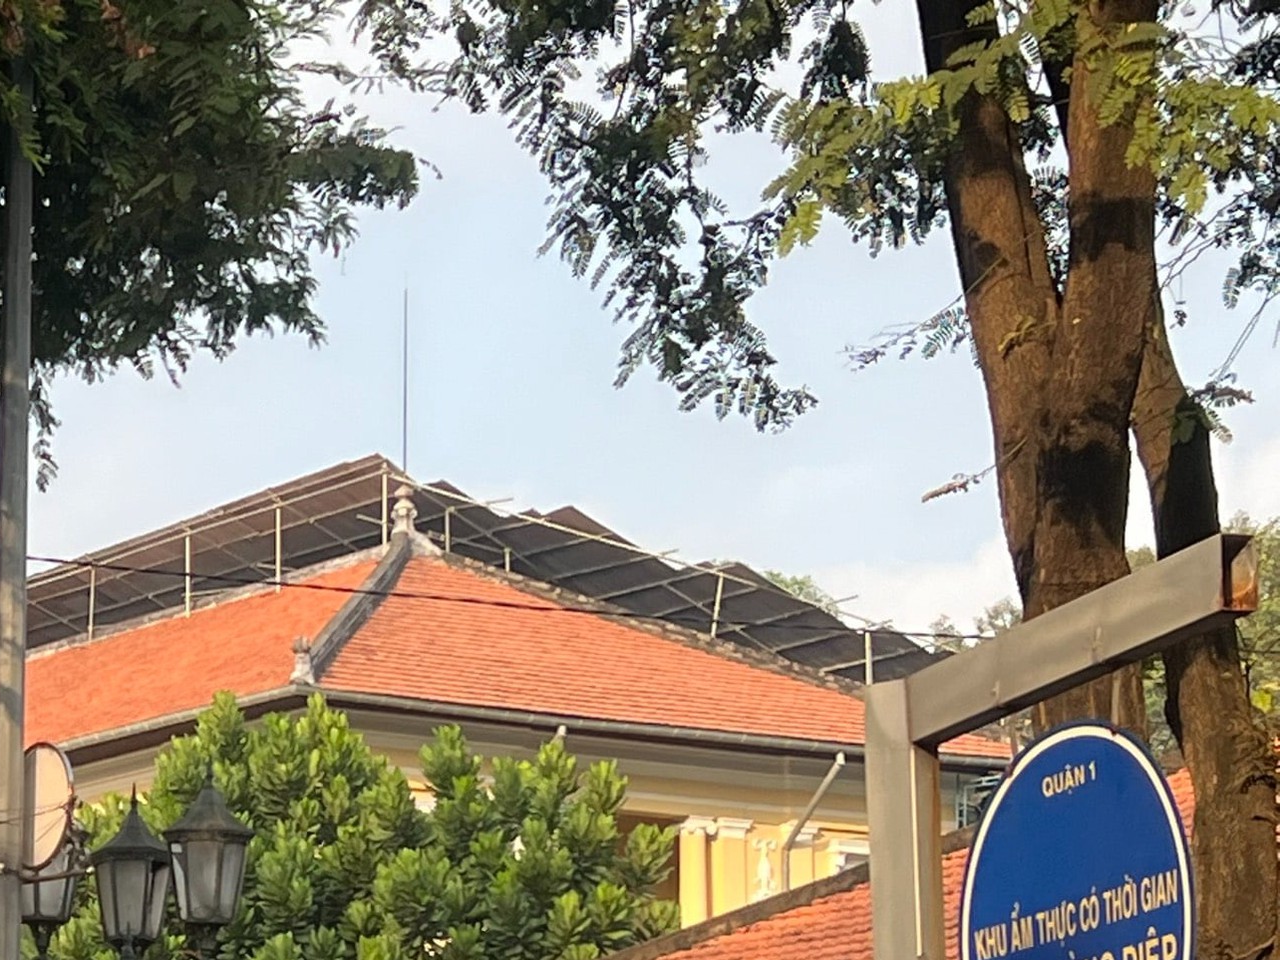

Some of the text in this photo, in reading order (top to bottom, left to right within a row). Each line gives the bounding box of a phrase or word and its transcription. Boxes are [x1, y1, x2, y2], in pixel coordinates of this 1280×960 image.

[1041, 760, 1096, 798] QUẬN 1
[1010, 901, 1035, 953] ẨM
[1035, 900, 1077, 948] THỰC
[1079, 886, 1100, 932] CÓ
[1102, 874, 1138, 925] THỜI
[1140, 868, 1179, 913] GIAN
